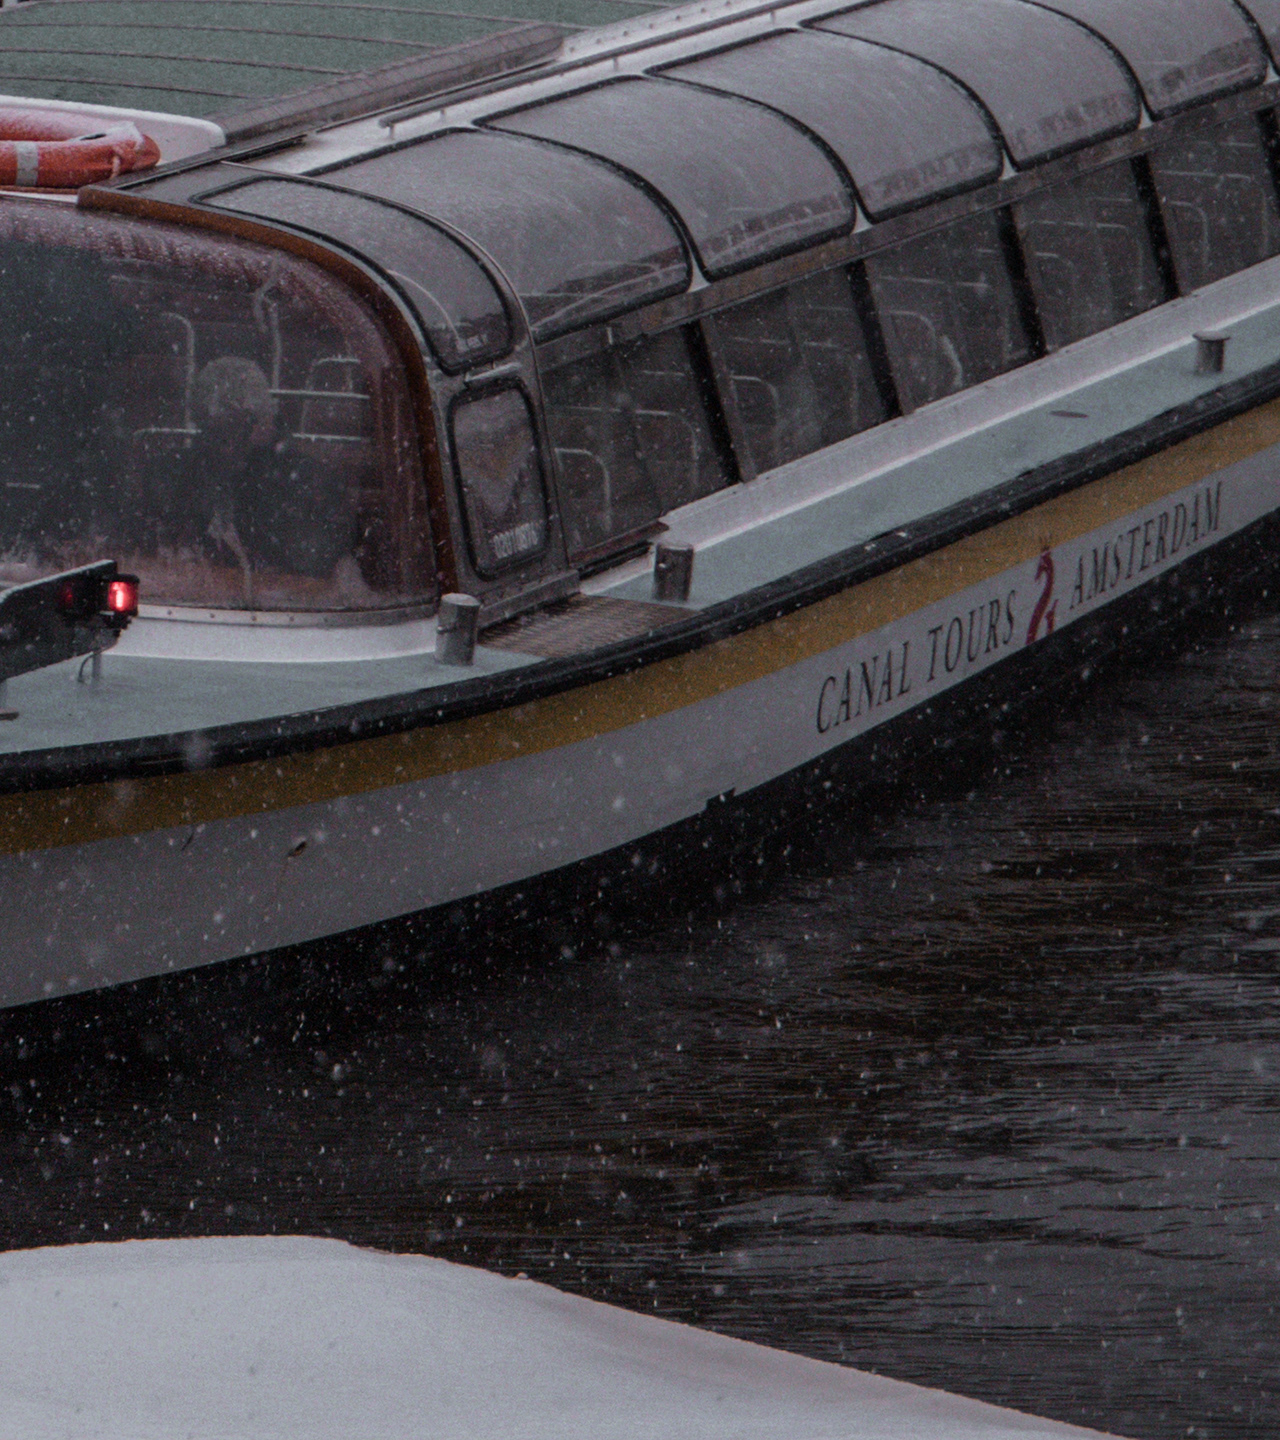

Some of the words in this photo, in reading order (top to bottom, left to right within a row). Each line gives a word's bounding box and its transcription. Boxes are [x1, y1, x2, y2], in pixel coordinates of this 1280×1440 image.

[1069, 481, 1223, 610] AMSTERDAM
[816, 641, 913, 734] CANAL
[926, 590, 1017, 682] TOURS
